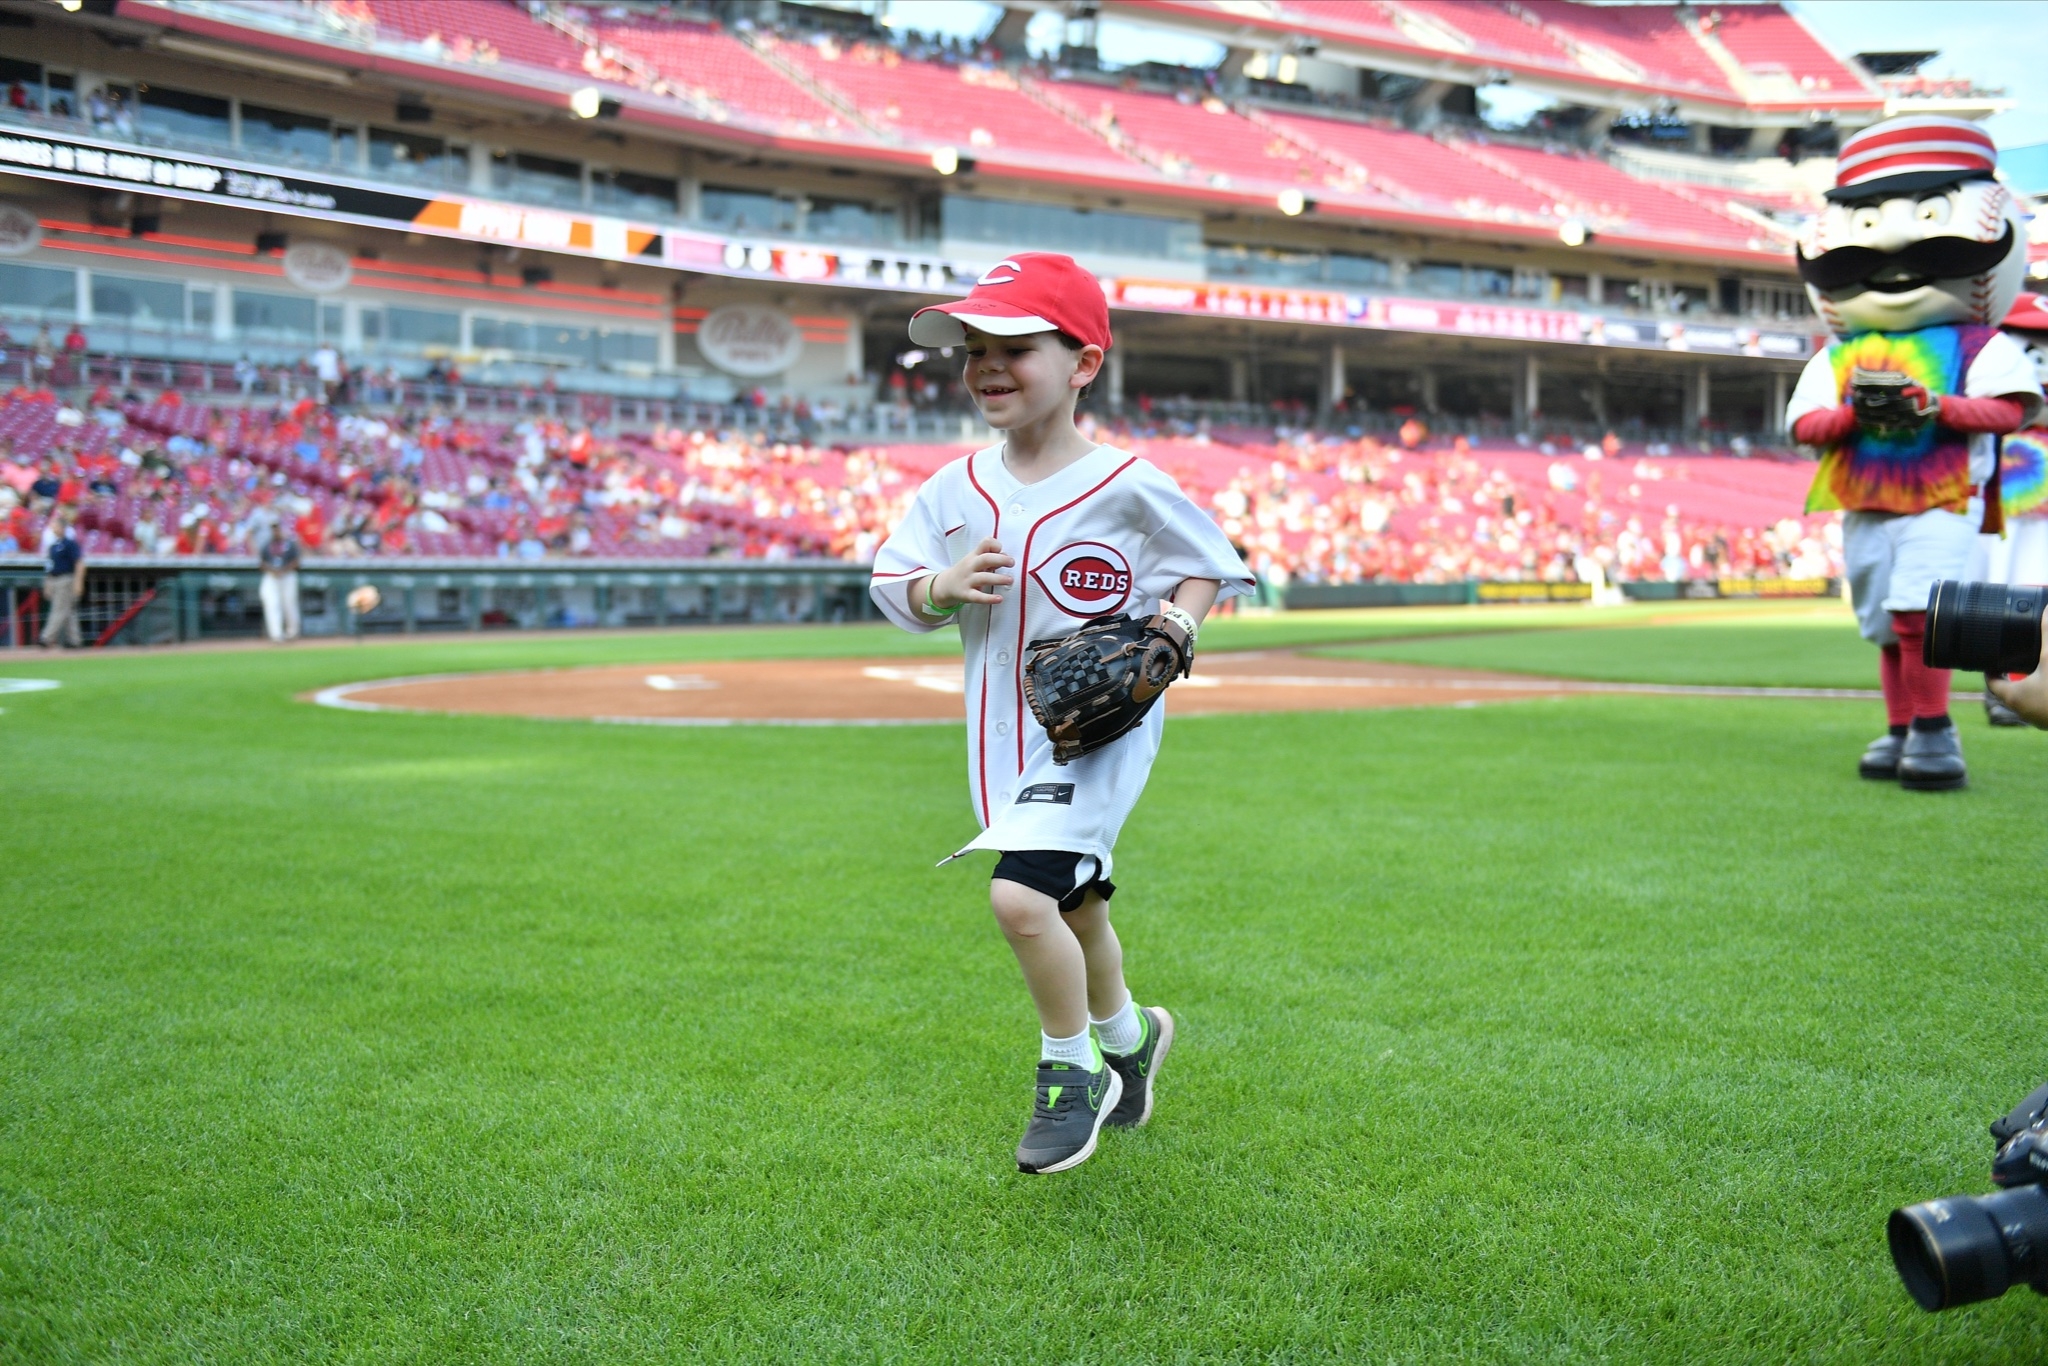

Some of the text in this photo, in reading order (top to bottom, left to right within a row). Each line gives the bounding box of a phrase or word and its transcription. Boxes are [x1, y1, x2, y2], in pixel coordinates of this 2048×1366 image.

[977, 260, 1021, 286] C
[707, 309, 791, 355] Bally
[1063, 569, 1128, 592] REDS
